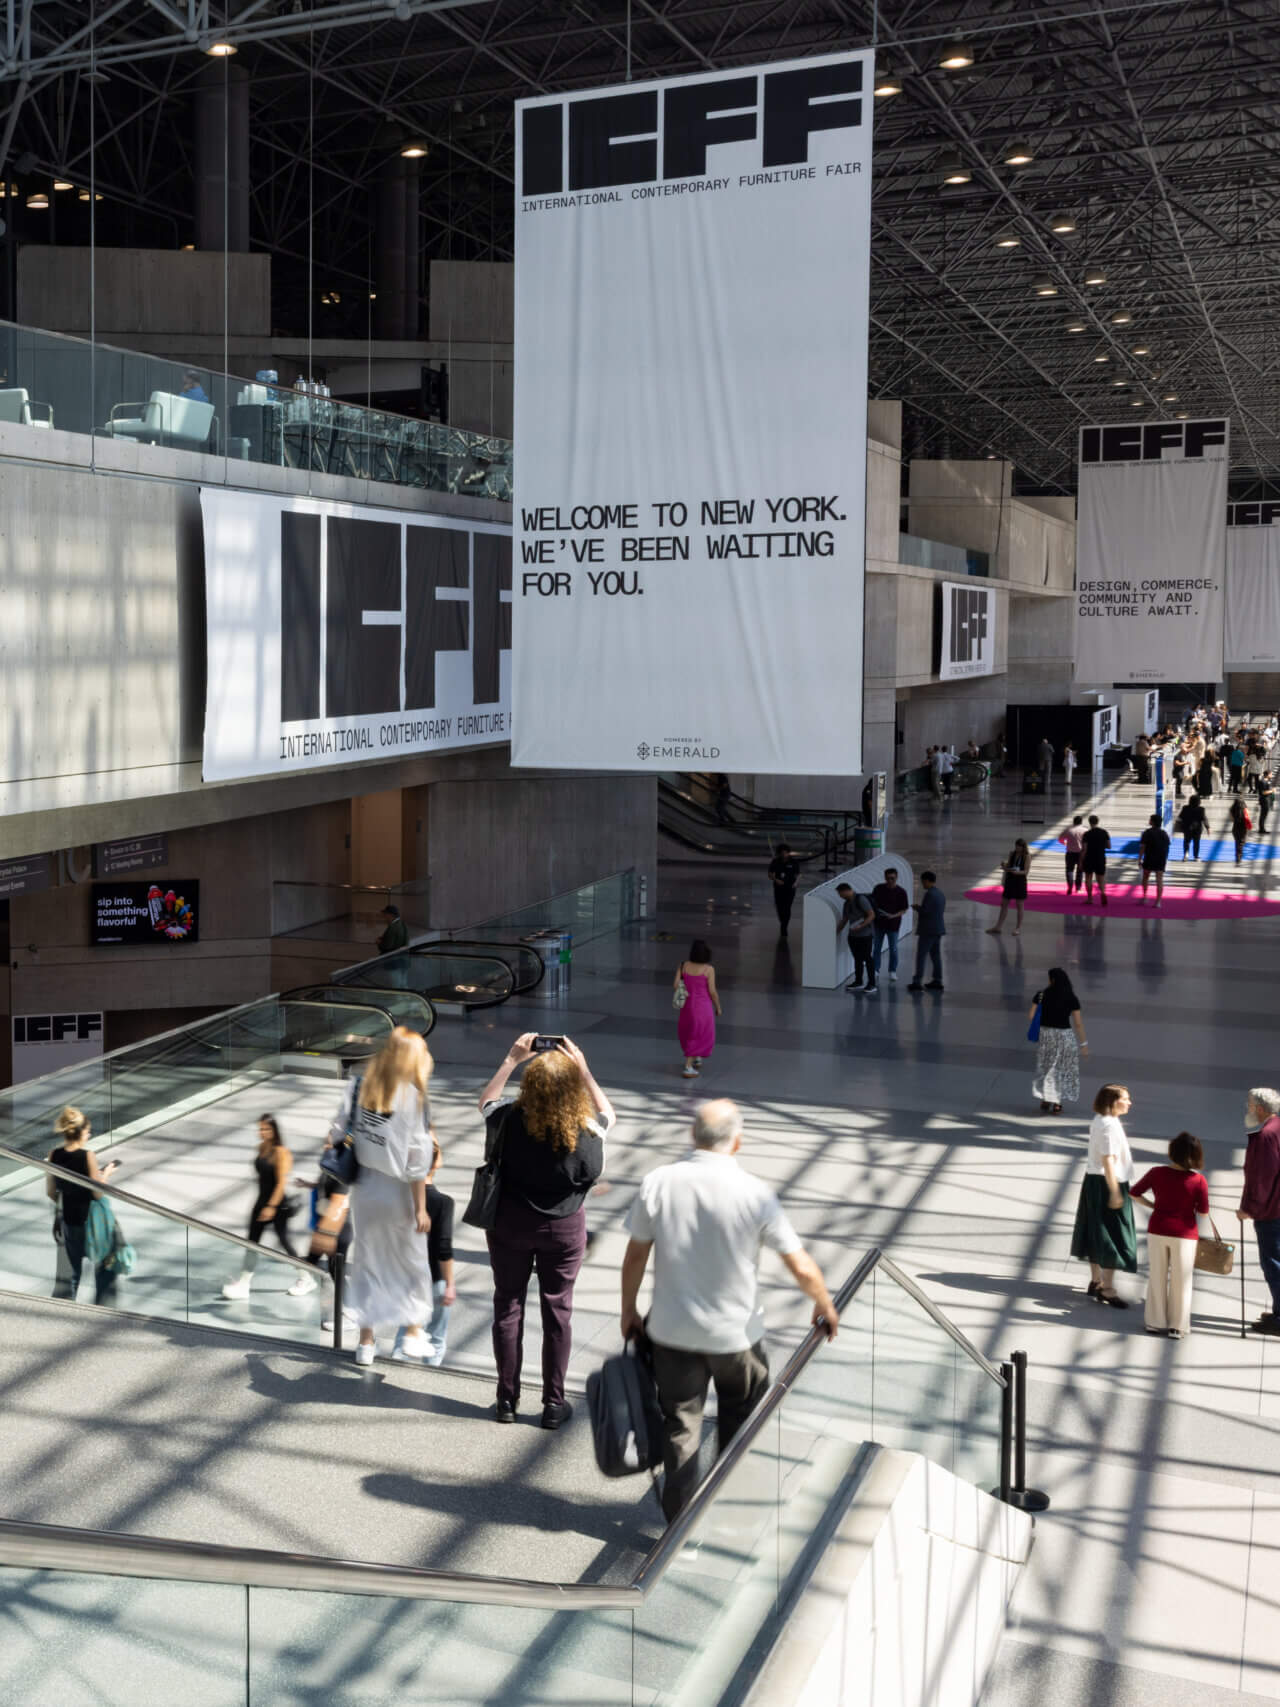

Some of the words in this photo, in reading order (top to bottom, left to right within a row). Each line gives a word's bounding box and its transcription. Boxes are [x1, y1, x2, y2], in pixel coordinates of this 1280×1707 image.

[522, 60, 864, 197] ICFF
[521, 191, 623, 213] INTERNATIONAL
[631, 178, 731, 201] CONTEMPORARY
[738, 167, 817, 187] FURNITURE
[825, 161, 863, 178] FAIR
[1082, 420, 1226, 463] ICFF
[521, 504, 639, 532] WELCOME
[652, 501, 688, 528] TO
[701, 499, 756, 526] NEW
[764, 495, 848, 523] YORK.
[521, 537, 606, 564] WE'VE
[621, 535, 690, 562] BEEN
[706, 530, 835, 560] WAITING
[521, 571, 572, 596] FOR
[587, 570, 644, 596] YOU.
[1079, 580, 1138, 593] DESIGN,
[1140, 578, 1219, 592] COMMERCE,
[1078, 592, 1157, 604] COMMUNITY
[1165, 592, 1193, 603] AND
[1078, 606, 1140, 617] CULTURE
[1147, 604, 1200, 617] AWAIT.
[279, 727, 374, 759] INTERNATIONAL
[380, 718, 453, 747] CONTEMPORARY
[457, 711, 505, 737] FURNITURE
[653, 745, 720, 759] EMERALD
[97, 897, 113, 908] sip
[114, 896, 133, 906] into
[97, 906, 149, 918] something
[97, 916, 137, 927] flavorful
[14, 1013, 102, 1042] ICFF
